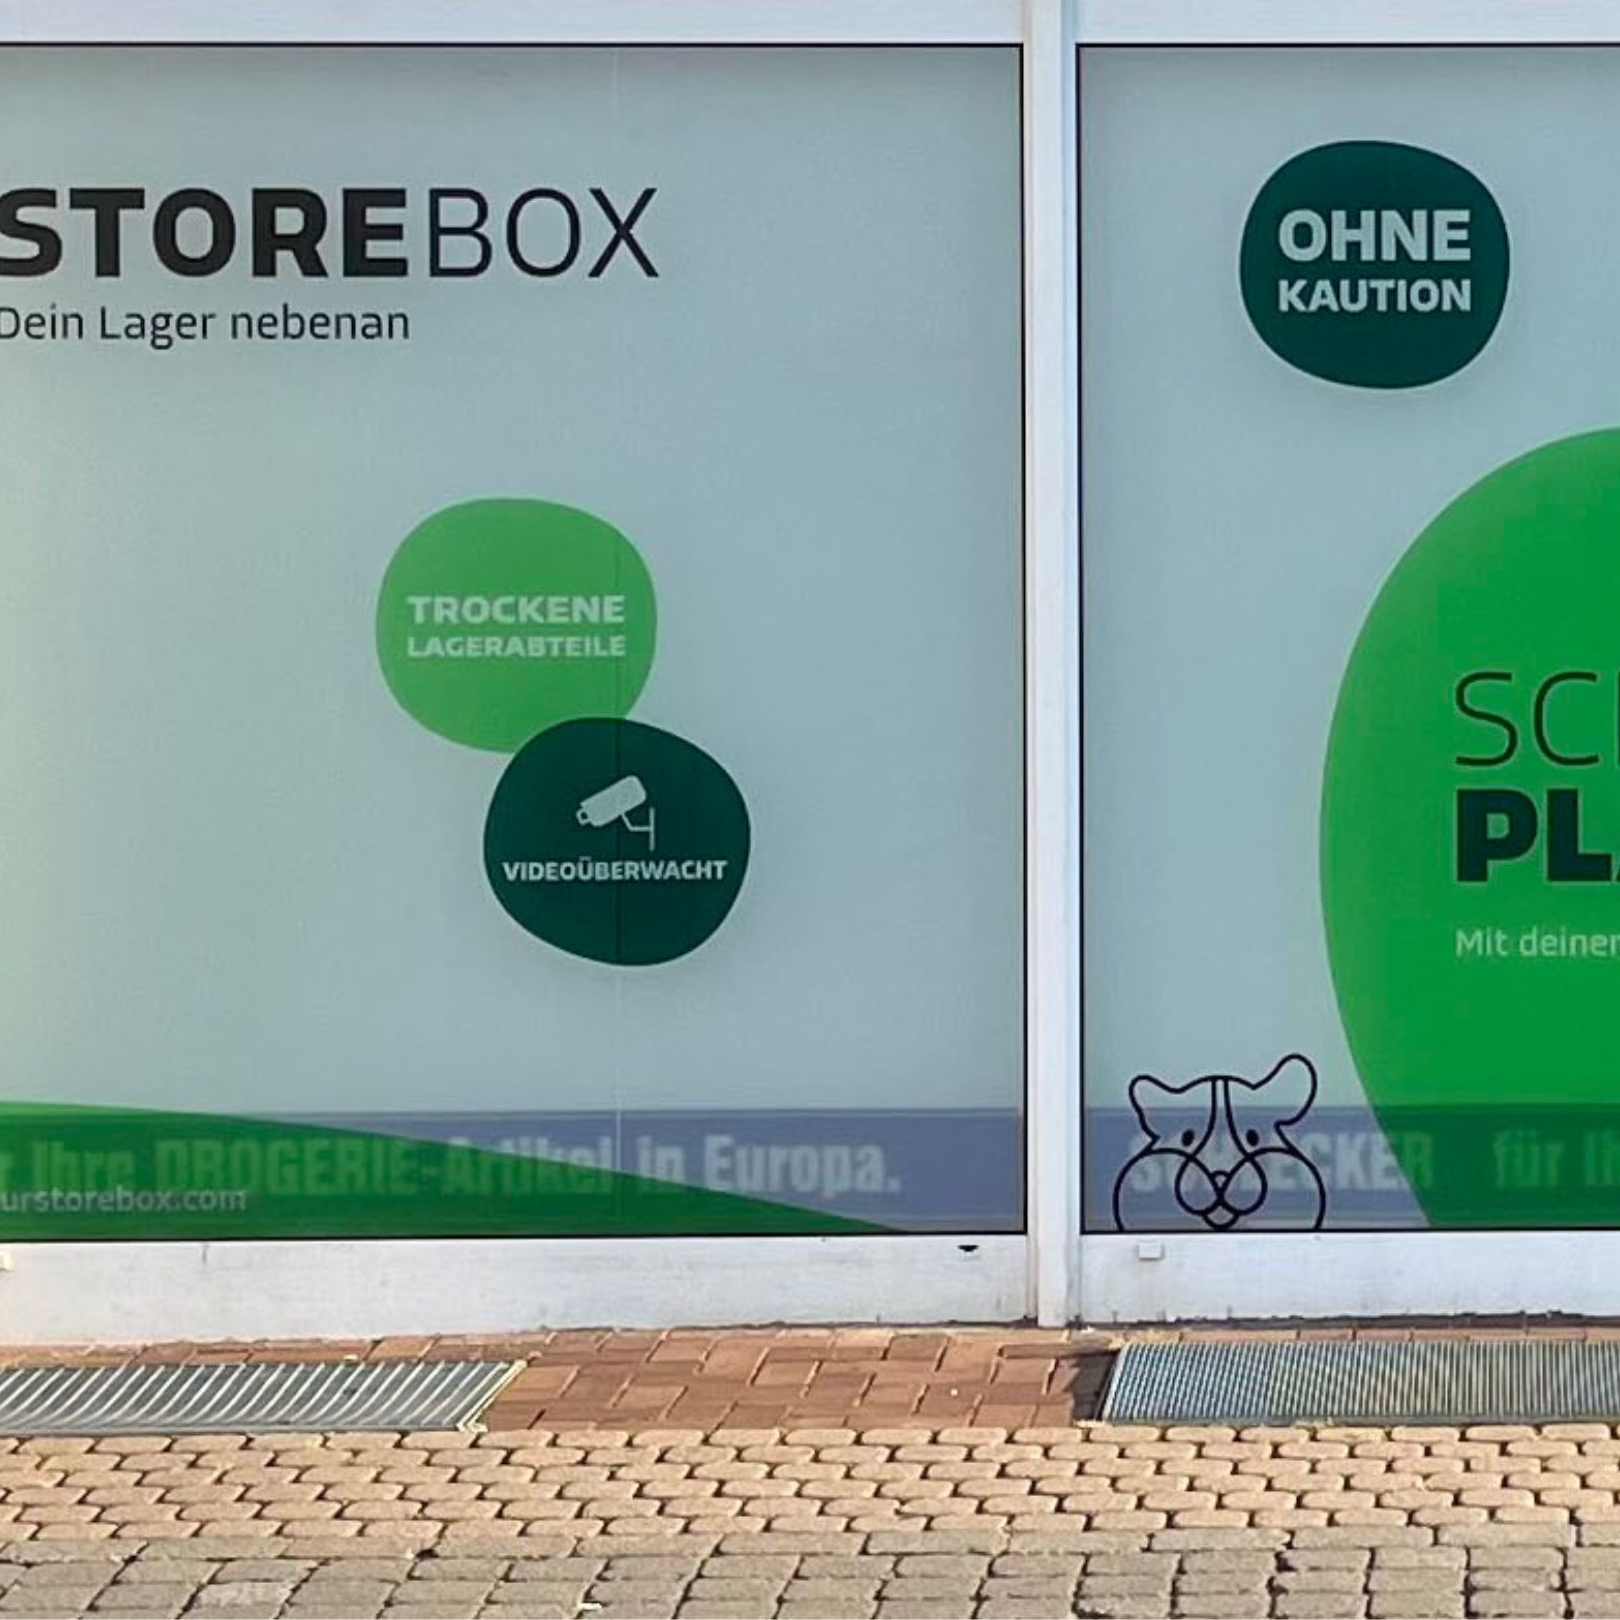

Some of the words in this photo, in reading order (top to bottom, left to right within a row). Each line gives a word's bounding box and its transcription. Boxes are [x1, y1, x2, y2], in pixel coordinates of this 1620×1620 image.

[1278, 209, 1471, 262] OHNE
[1278, 279, 1471, 311] KAUTION
[99, 306, 216, 350] Lager
[231, 302, 409, 340] nebenan
[407, 595, 625, 624] TROCKENE
[408, 635, 626, 657] LAGERABTEILE
[502, 856, 728, 881] VIDEOÜBERWACHT
[1456, 928, 1508, 957] Mit
[154, 1137, 612, 1195] DROGERIE-Artikel
[639, 1136, 684, 1194] in
[704, 1135, 900, 1198] Europa.
[1494, 1130, 1561, 1188] für
